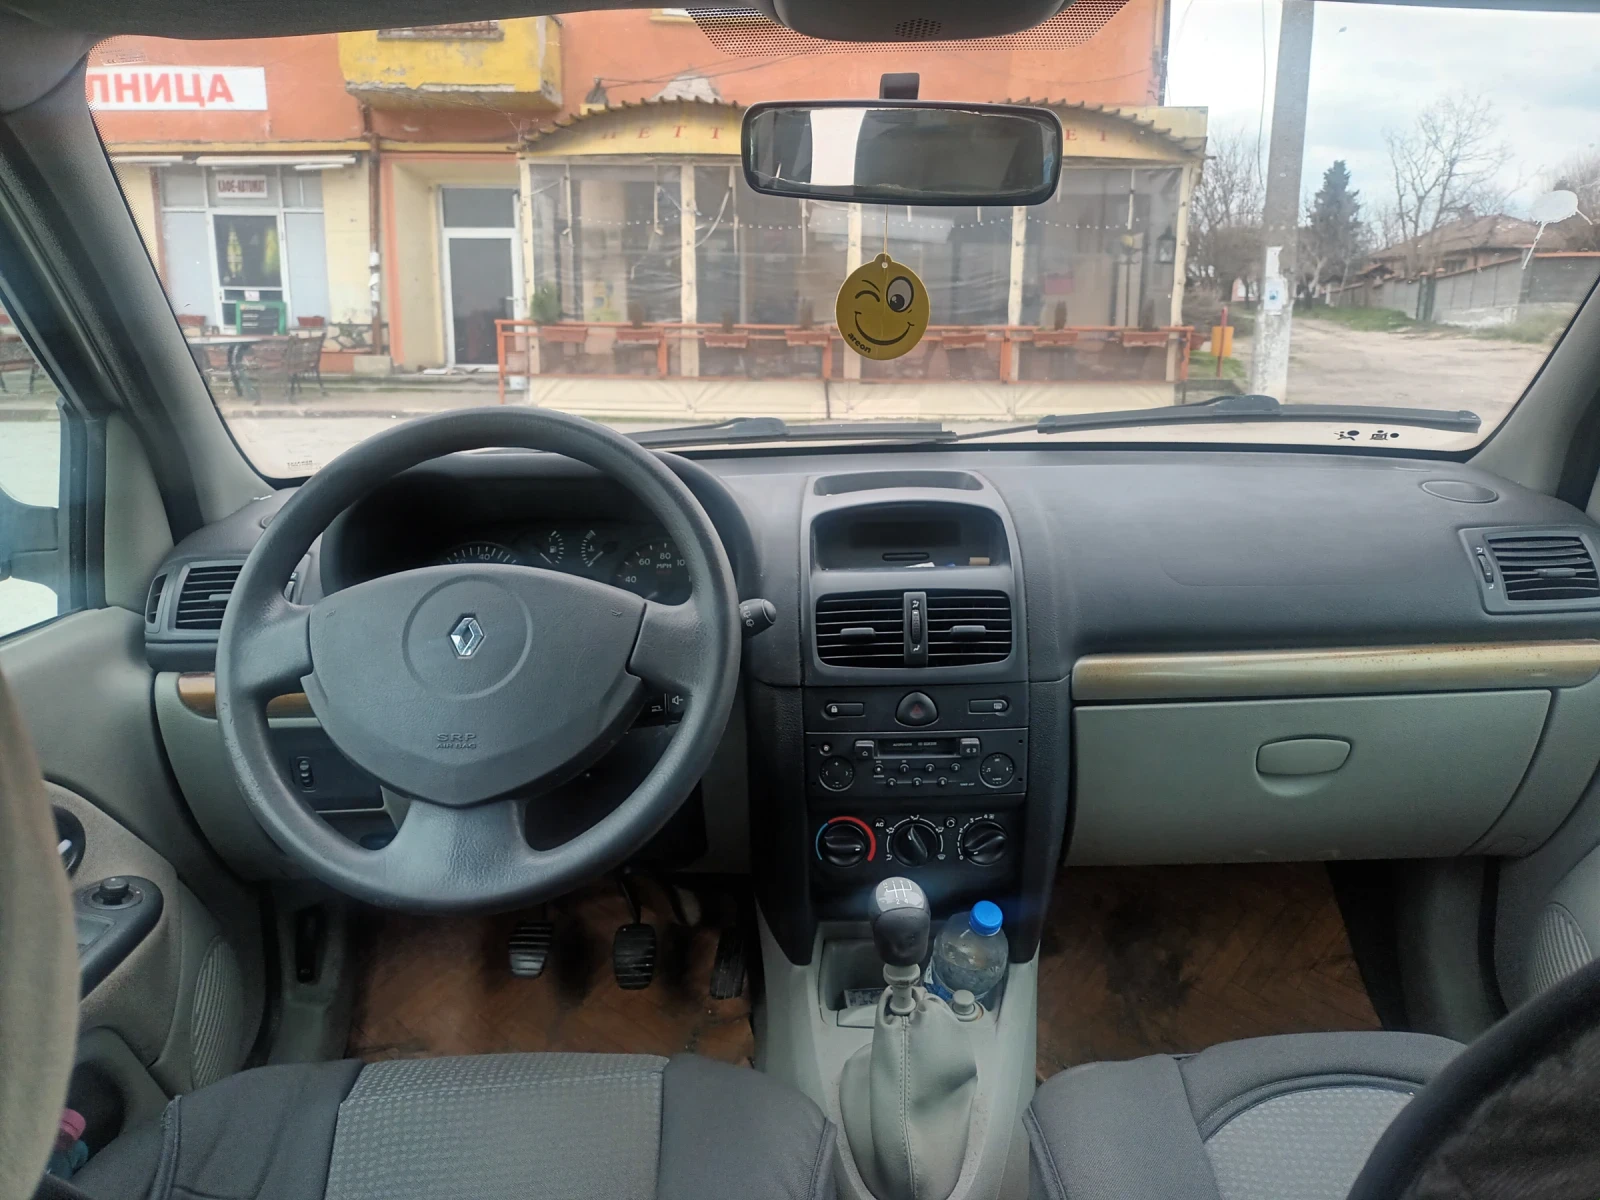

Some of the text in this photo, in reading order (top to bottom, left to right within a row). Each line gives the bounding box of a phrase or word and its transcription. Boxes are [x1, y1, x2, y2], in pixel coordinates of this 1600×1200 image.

[848, 333, 871, 353] areon
[478, 553, 491, 561] 40
[660, 552, 671, 560] 80
[638, 558, 651, 566] 60
[676, 559, 686, 567] 10
[625, 575, 637, 583] 40
[437, 732, 477, 742] SRP
